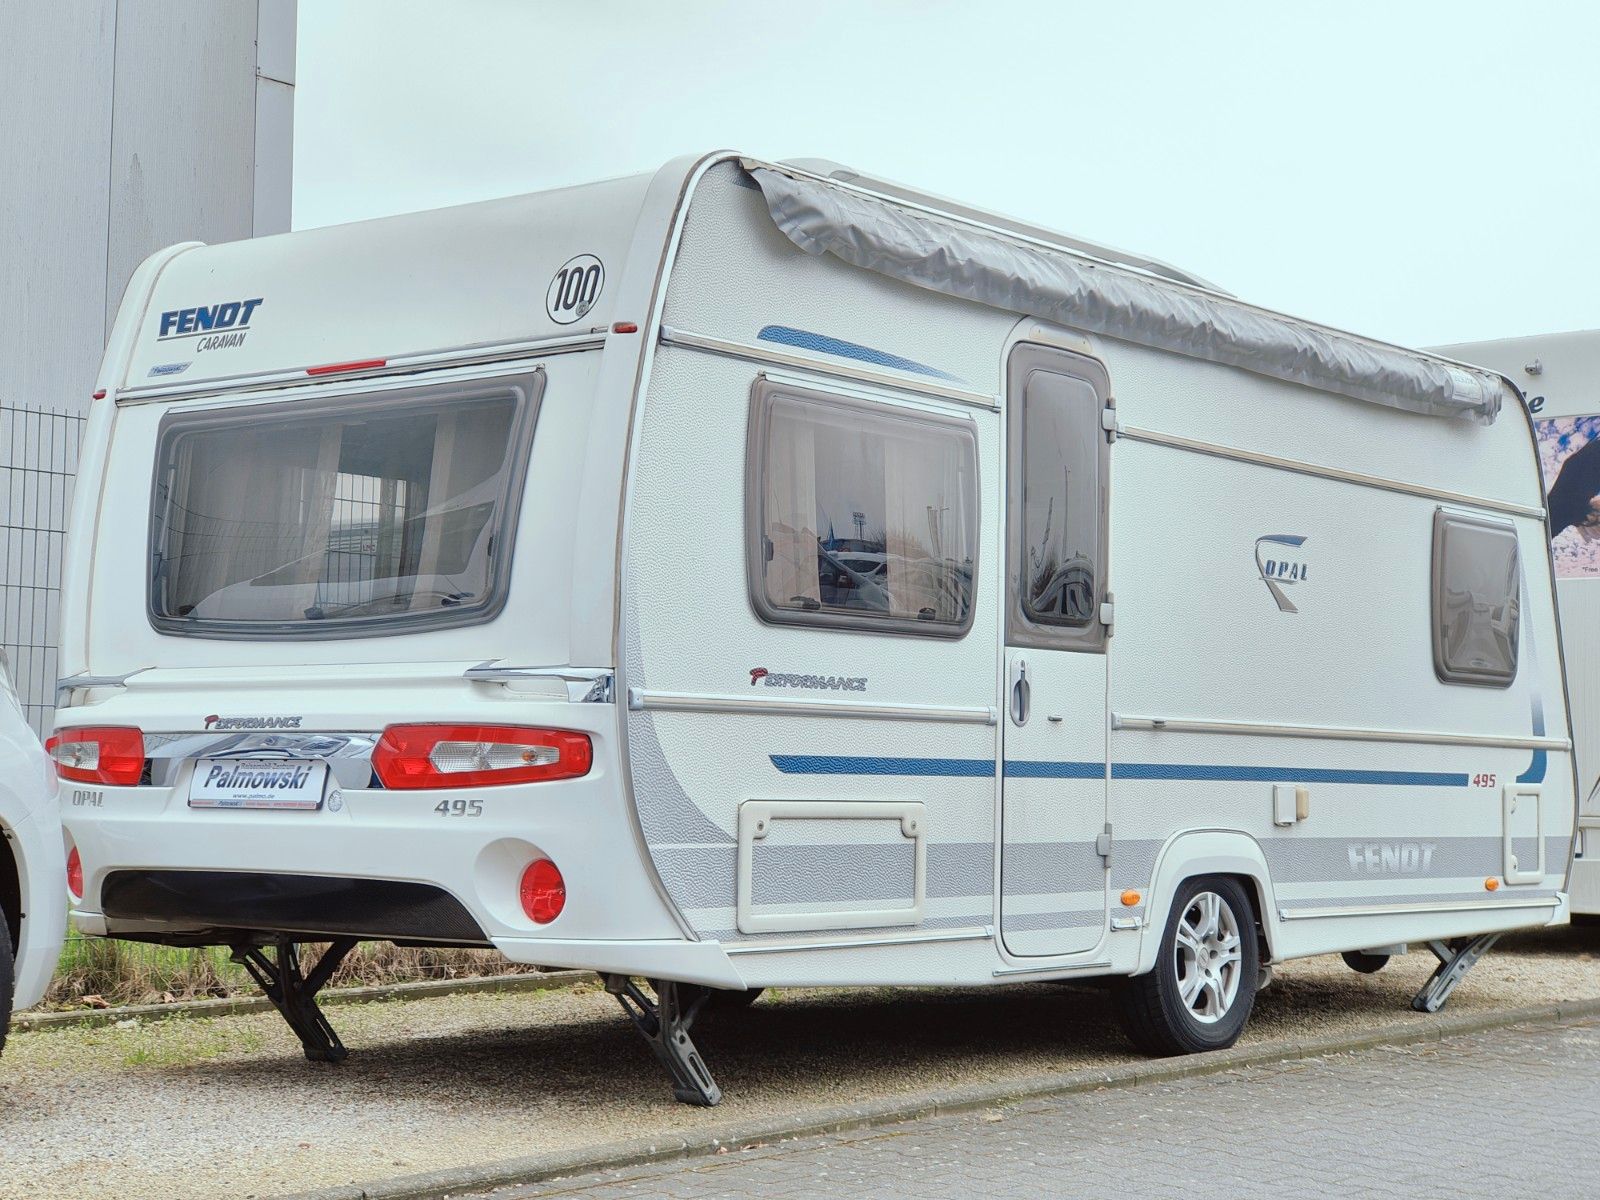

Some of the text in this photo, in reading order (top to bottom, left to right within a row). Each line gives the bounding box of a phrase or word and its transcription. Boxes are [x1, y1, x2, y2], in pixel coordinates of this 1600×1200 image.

[553, 264, 600, 312] 100
[159, 298, 264, 337] FENDT
[196, 332, 246, 353] CARAVAN
[1265, 559, 1307, 581] OPAL
[203, 765, 313, 789] Palmowski
[1472, 773, 1497, 788] 495
[72, 790, 104, 807] OPAL
[434, 799, 484, 817] 495
[1348, 843, 1437, 874] FENDT
